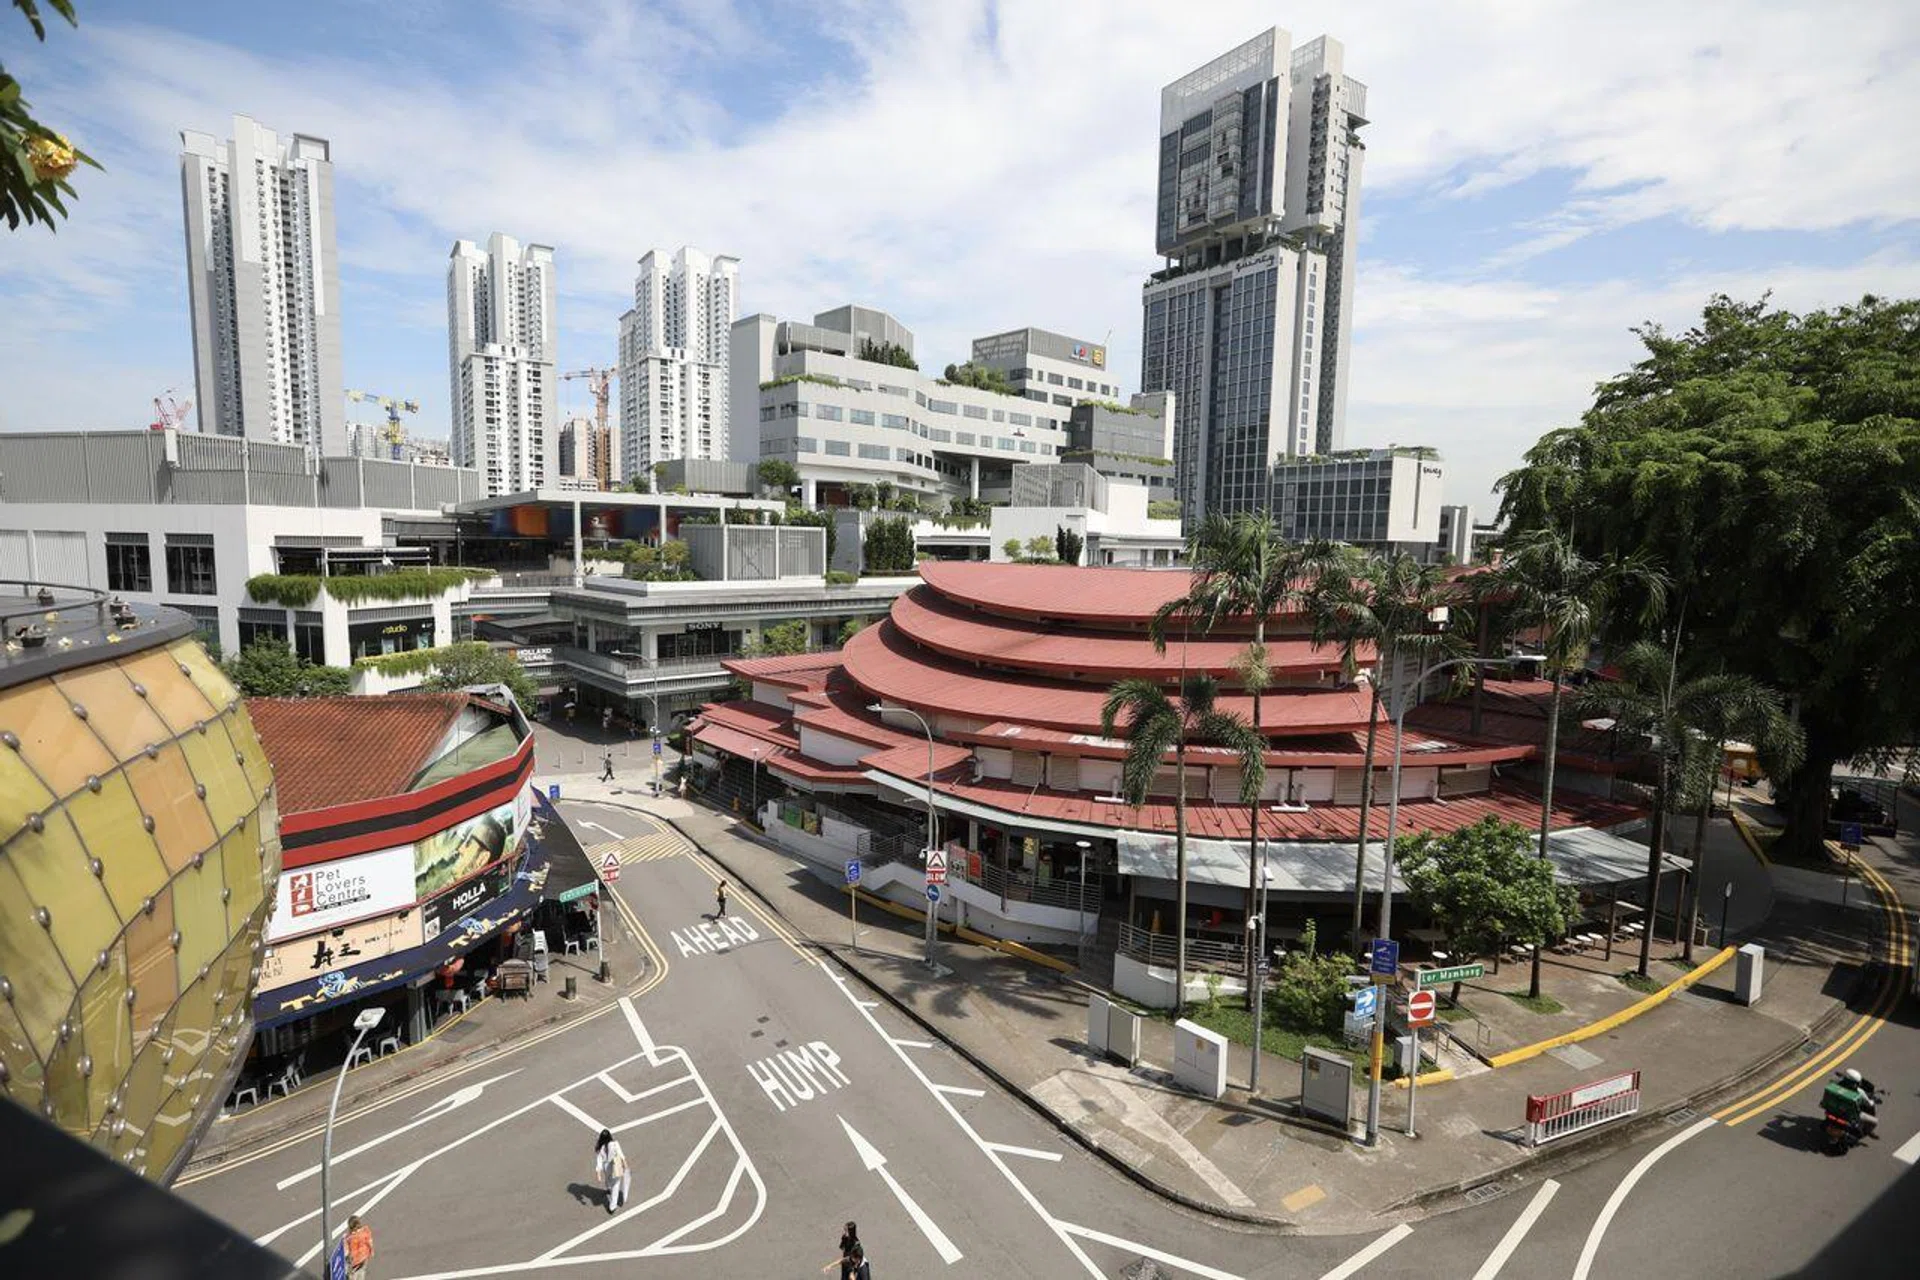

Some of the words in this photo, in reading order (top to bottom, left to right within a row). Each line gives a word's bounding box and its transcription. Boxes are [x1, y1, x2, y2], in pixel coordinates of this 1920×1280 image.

[688, 622, 720, 631] SONY
[315, 869, 341, 881] Pet
[316, 876, 366, 895] Lovers
[316, 886, 366, 906] Centre
[452, 882, 487, 910] HOLLA
[671, 917, 759, 958] AHEAD
[746, 1041, 851, 1111] HUMP
